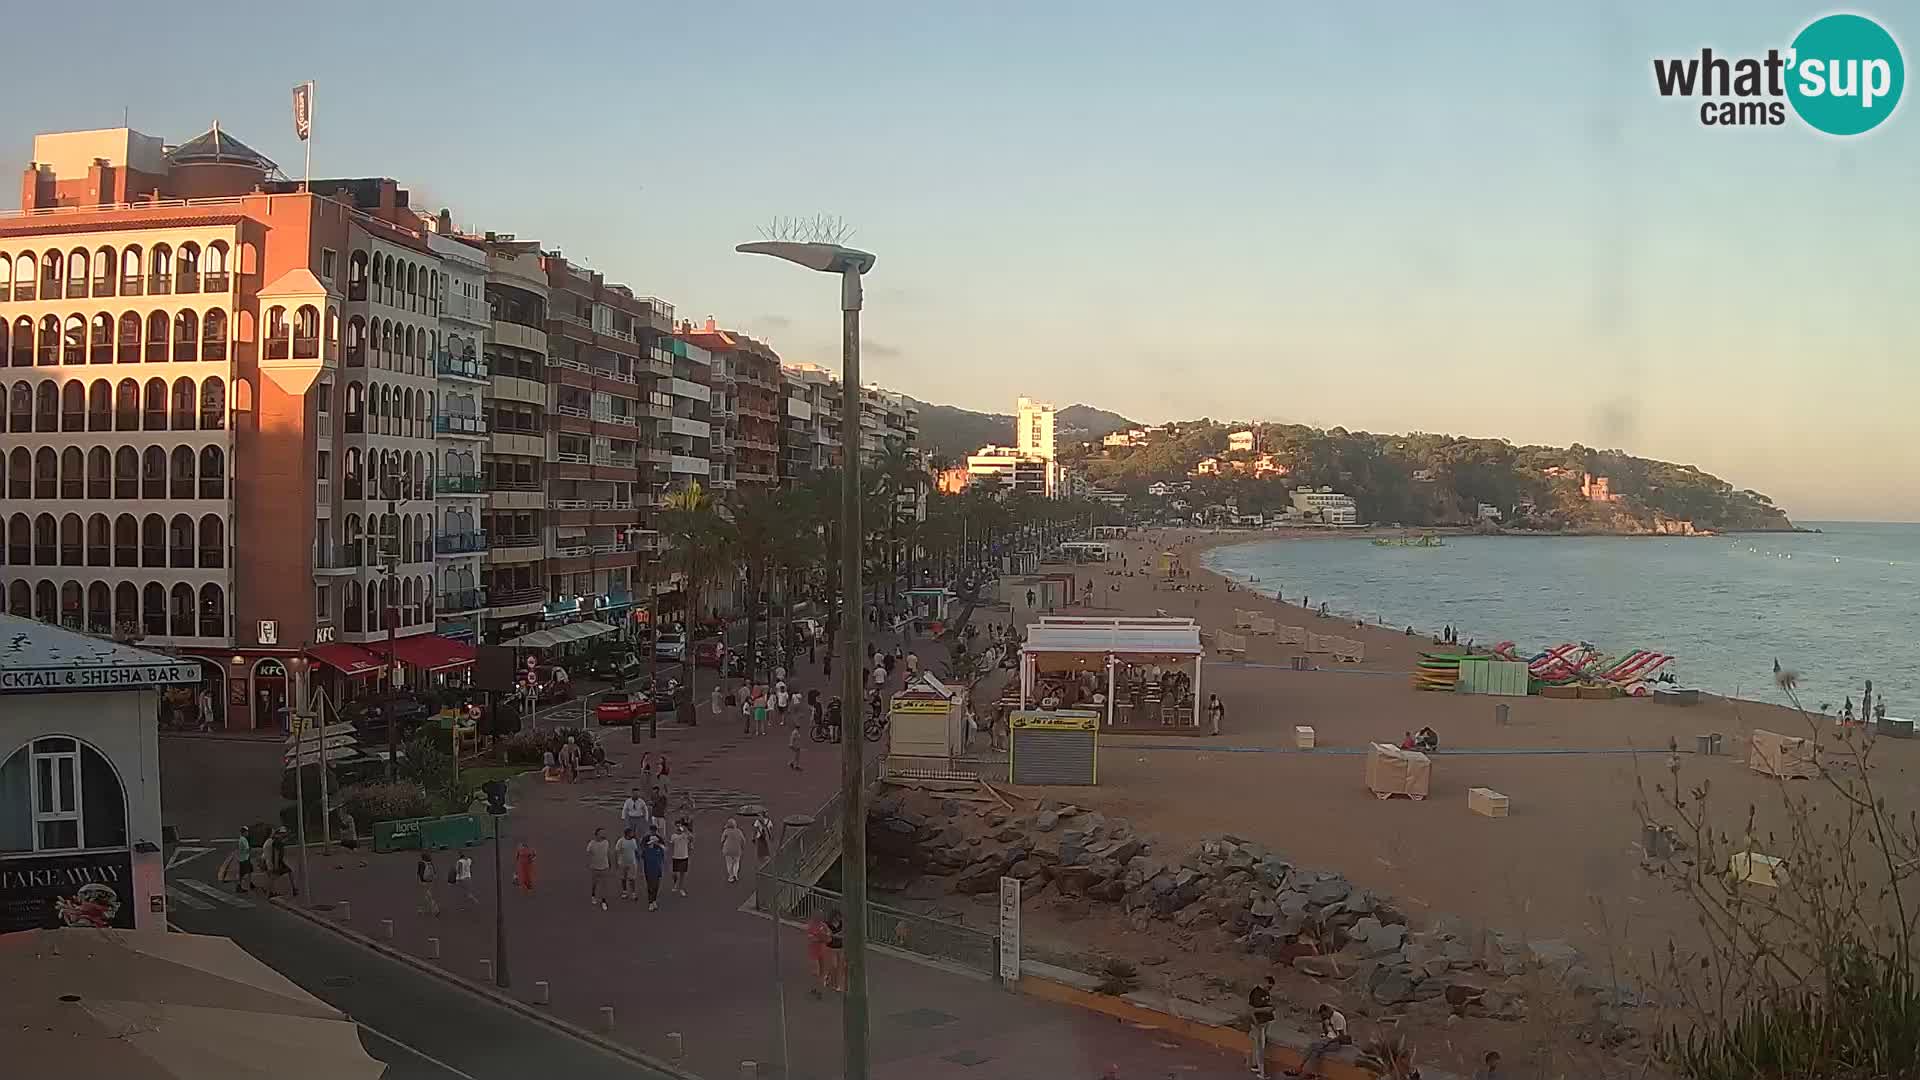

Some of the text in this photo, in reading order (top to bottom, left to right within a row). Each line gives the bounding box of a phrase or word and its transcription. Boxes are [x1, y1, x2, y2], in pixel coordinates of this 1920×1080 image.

[316, 627, 335, 643] KFC
[65, 671, 76, 685] &
[82, 669, 142, 685] SHISHA
[148, 667, 180, 682] BAR
[260, 666, 283, 676] KFC
